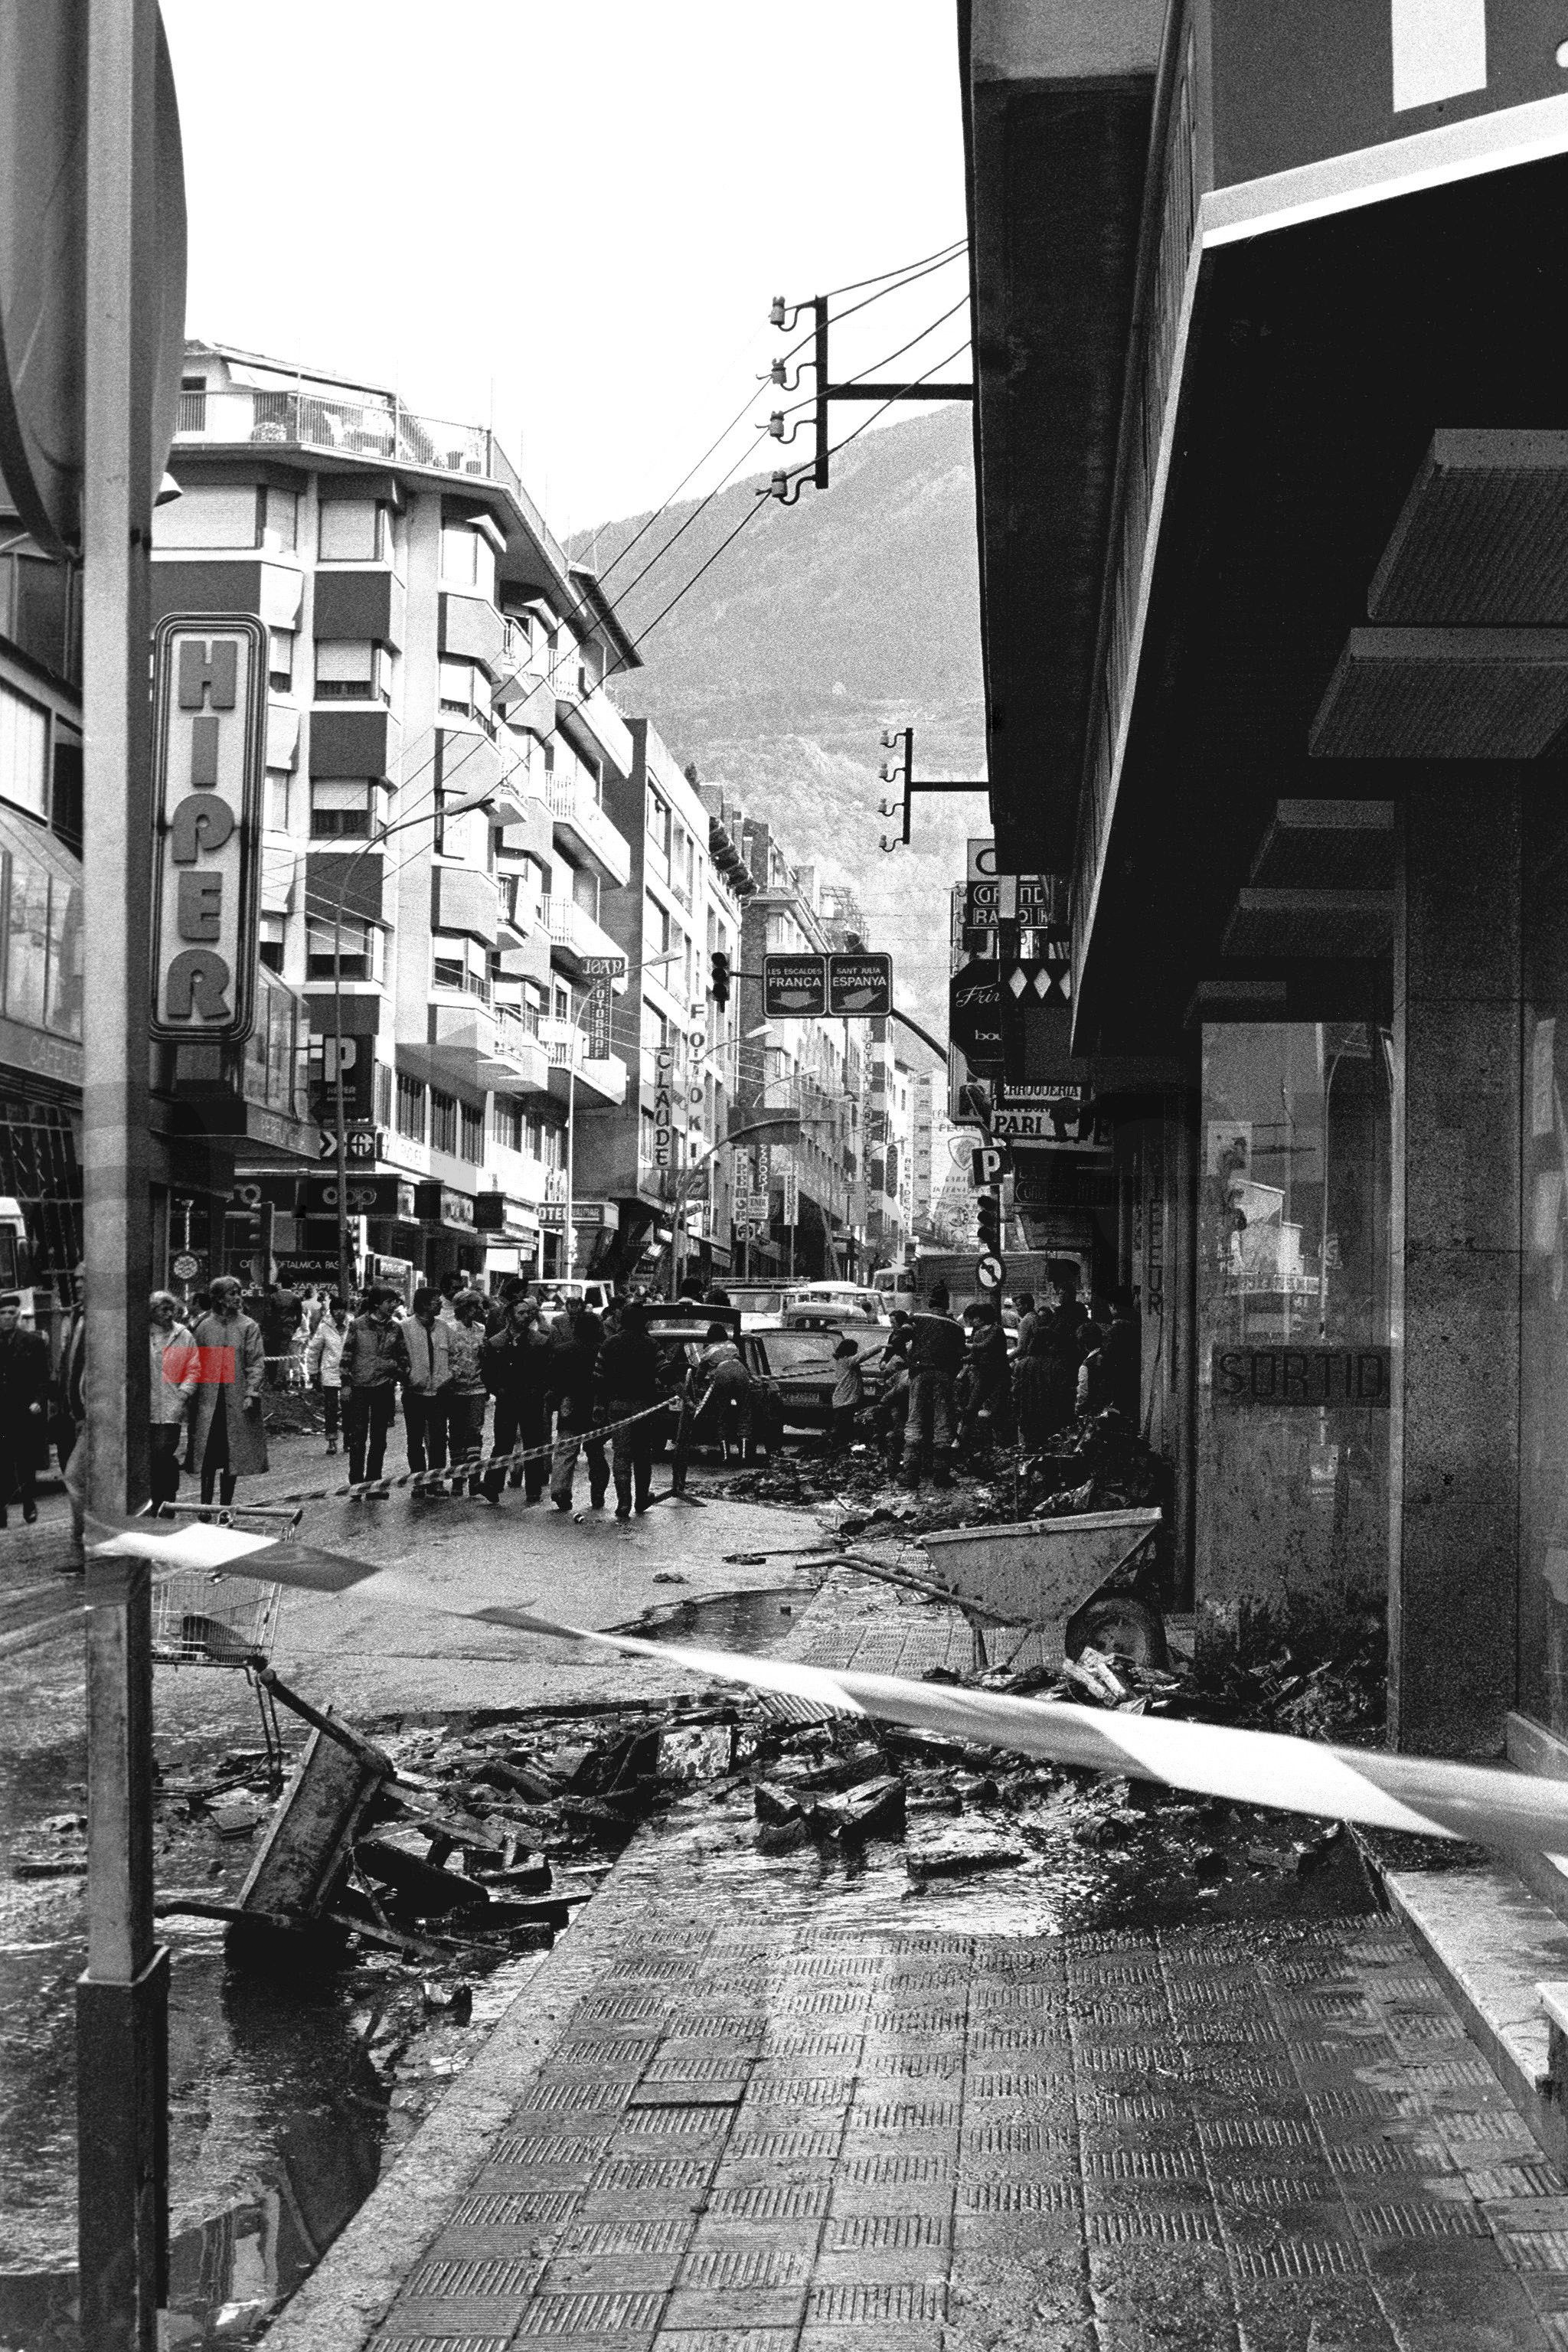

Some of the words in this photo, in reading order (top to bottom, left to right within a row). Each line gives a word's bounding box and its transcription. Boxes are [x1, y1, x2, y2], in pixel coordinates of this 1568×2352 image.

[166, 639, 238, 1020] HIPER
[784, 967, 823, 975] ESCALDES
[832, 975, 887, 988] ESPANYA
[768, 977, 822, 988] FRANÇA
[324, 1037, 357, 1083] P
[993, 1085, 1079, 1096] ERRUQUERIA
[655, 1050, 672, 1167] CLAUDE
[982, 1150, 1001, 1182] P
